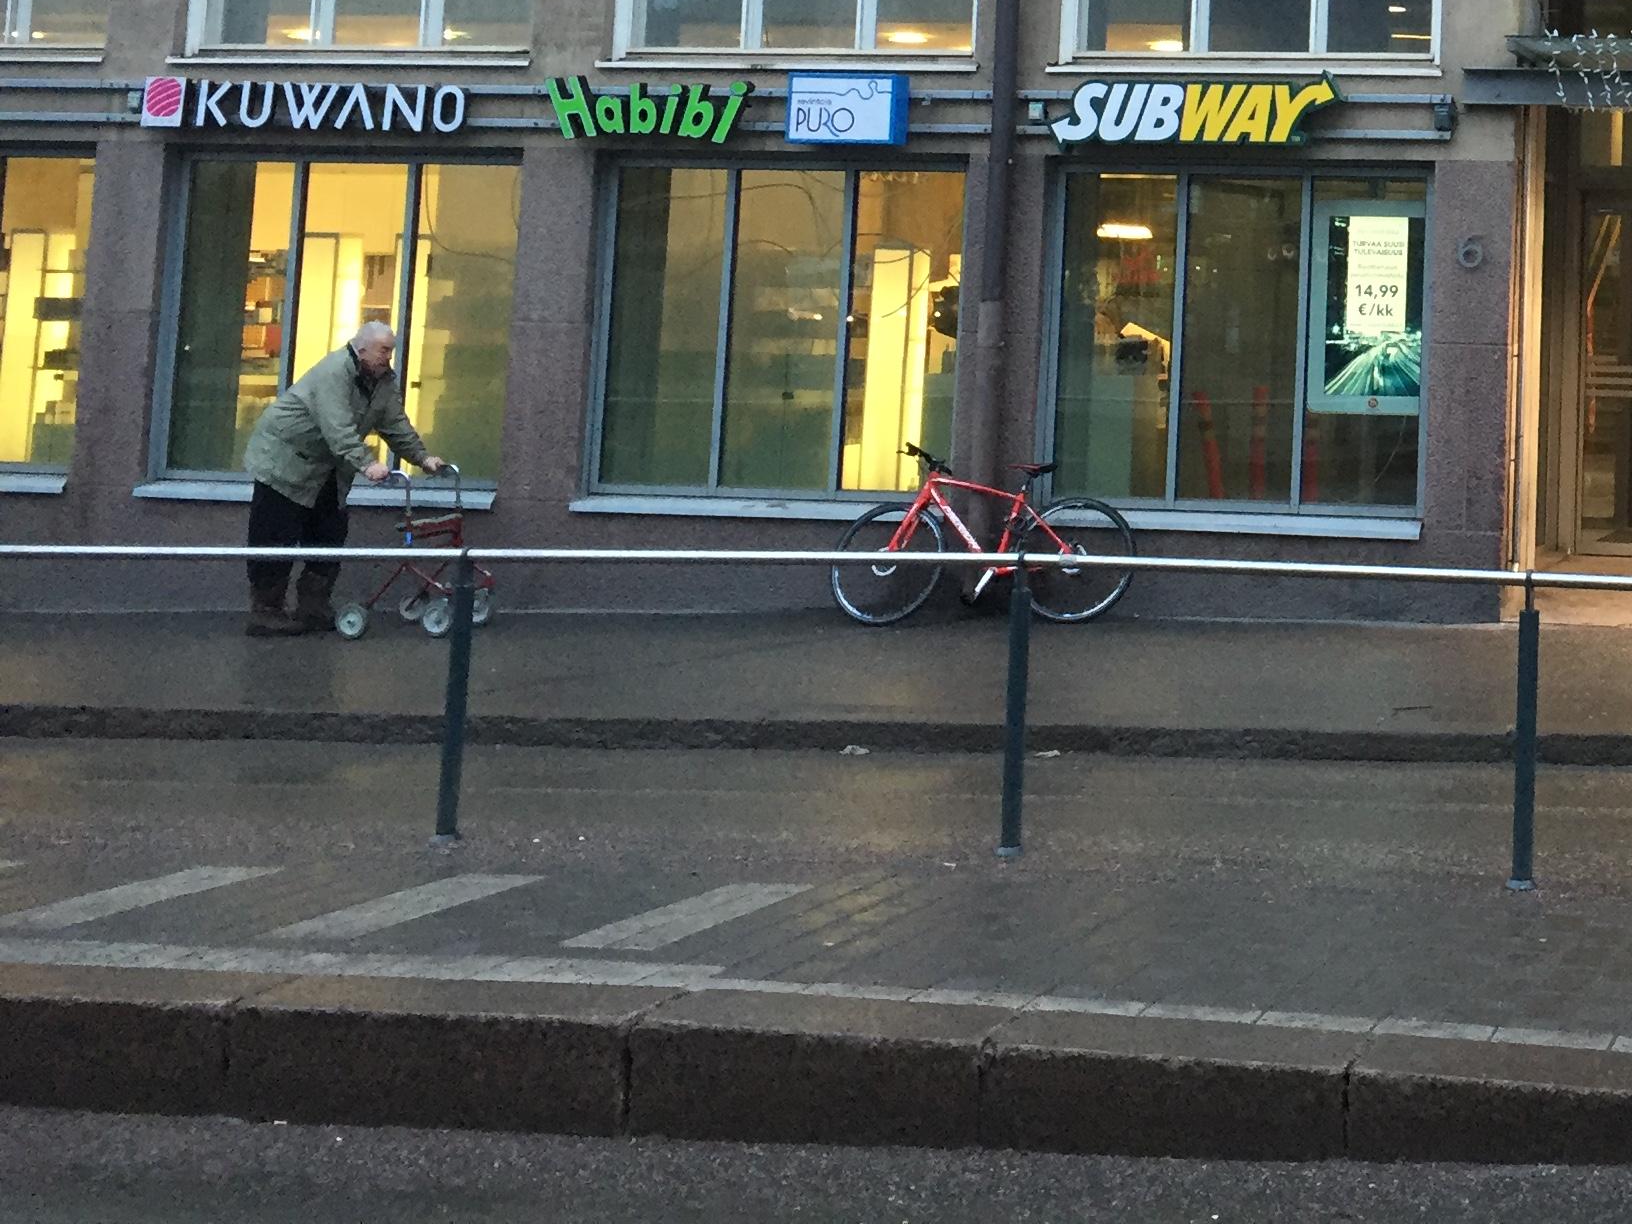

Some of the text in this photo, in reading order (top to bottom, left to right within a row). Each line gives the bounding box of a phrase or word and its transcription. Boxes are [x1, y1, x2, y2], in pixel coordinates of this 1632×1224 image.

[196, 80, 466, 133] KUWANO
[545, 75, 750, 144] Habibi
[795, 106, 855, 137] PURO
[1051, 79, 1335, 144] SUBWAY
[1355, 284, 1399, 299] 14,99
[1358, 303, 1393, 317] €/kk
